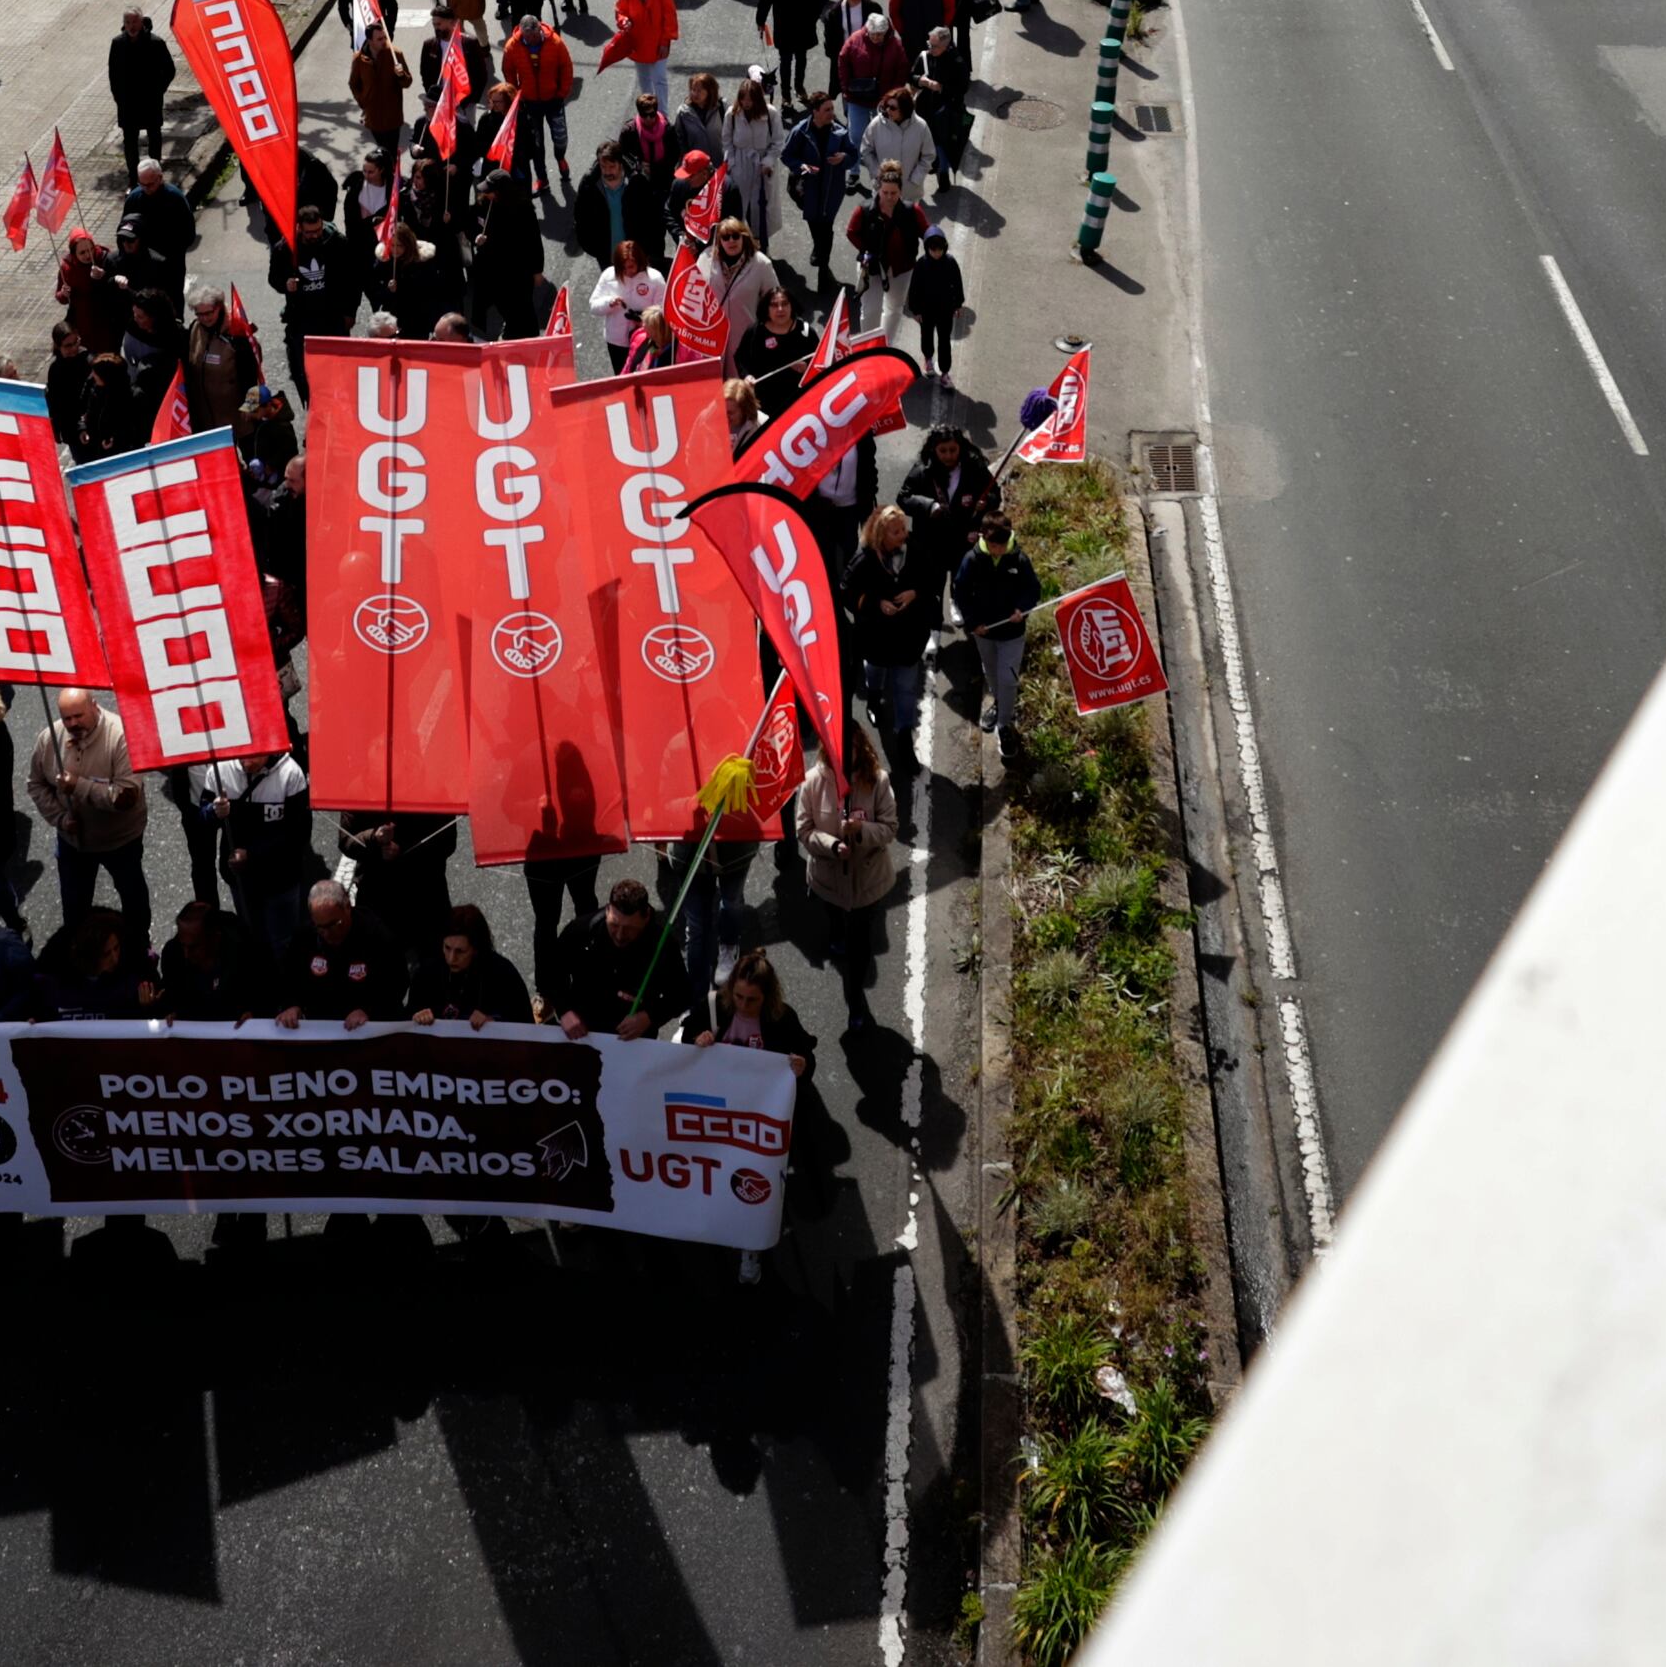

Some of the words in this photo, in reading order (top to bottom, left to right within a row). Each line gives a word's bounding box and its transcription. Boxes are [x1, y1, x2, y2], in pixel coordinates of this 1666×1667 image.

[357, 365, 429, 584] UGT
[473, 364, 544, 599] UGT
[605, 394, 695, 614] UGT
[103, 458, 251, 759] CCOO
[1091, 608, 1134, 666] UGT
[1088, 674, 1152, 700] www.ugt.es
[99, 1073, 208, 1100] POLO
[220, 1069, 358, 1102] PLENO
[370, 1069, 583, 1106] EMPREGO:
[105, 1110, 254, 1138] MENOS
[263, 1107, 477, 1144] XORNADA,
[674, 1111, 784, 1150] CCOO
[110, 1145, 326, 1174] MELLORES
[338, 1145, 537, 1177] SALARIOS
[619, 1148, 722, 1196] UGT
